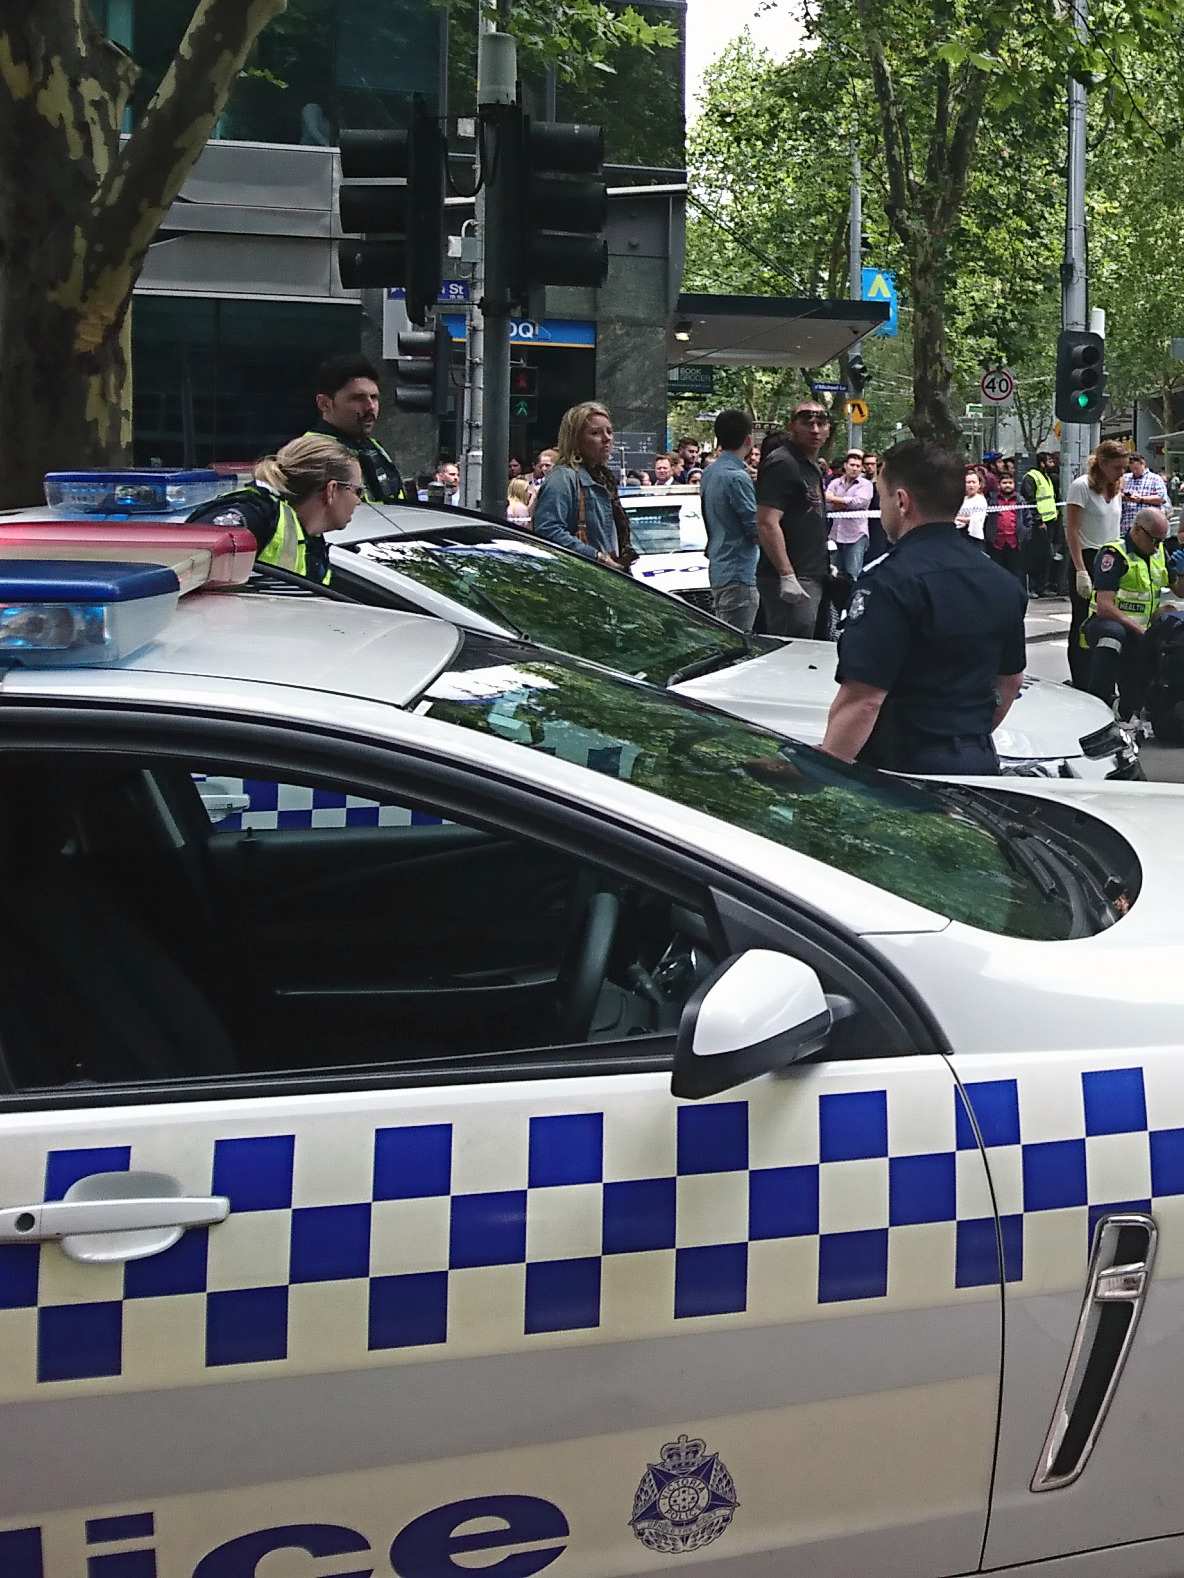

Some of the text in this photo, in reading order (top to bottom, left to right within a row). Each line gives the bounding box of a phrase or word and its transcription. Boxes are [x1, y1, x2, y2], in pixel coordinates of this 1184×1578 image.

[985, 377, 1009, 394] 40
[661, 1477, 706, 1500] VICTORIA
[664, 1503, 705, 1521] POLICE
